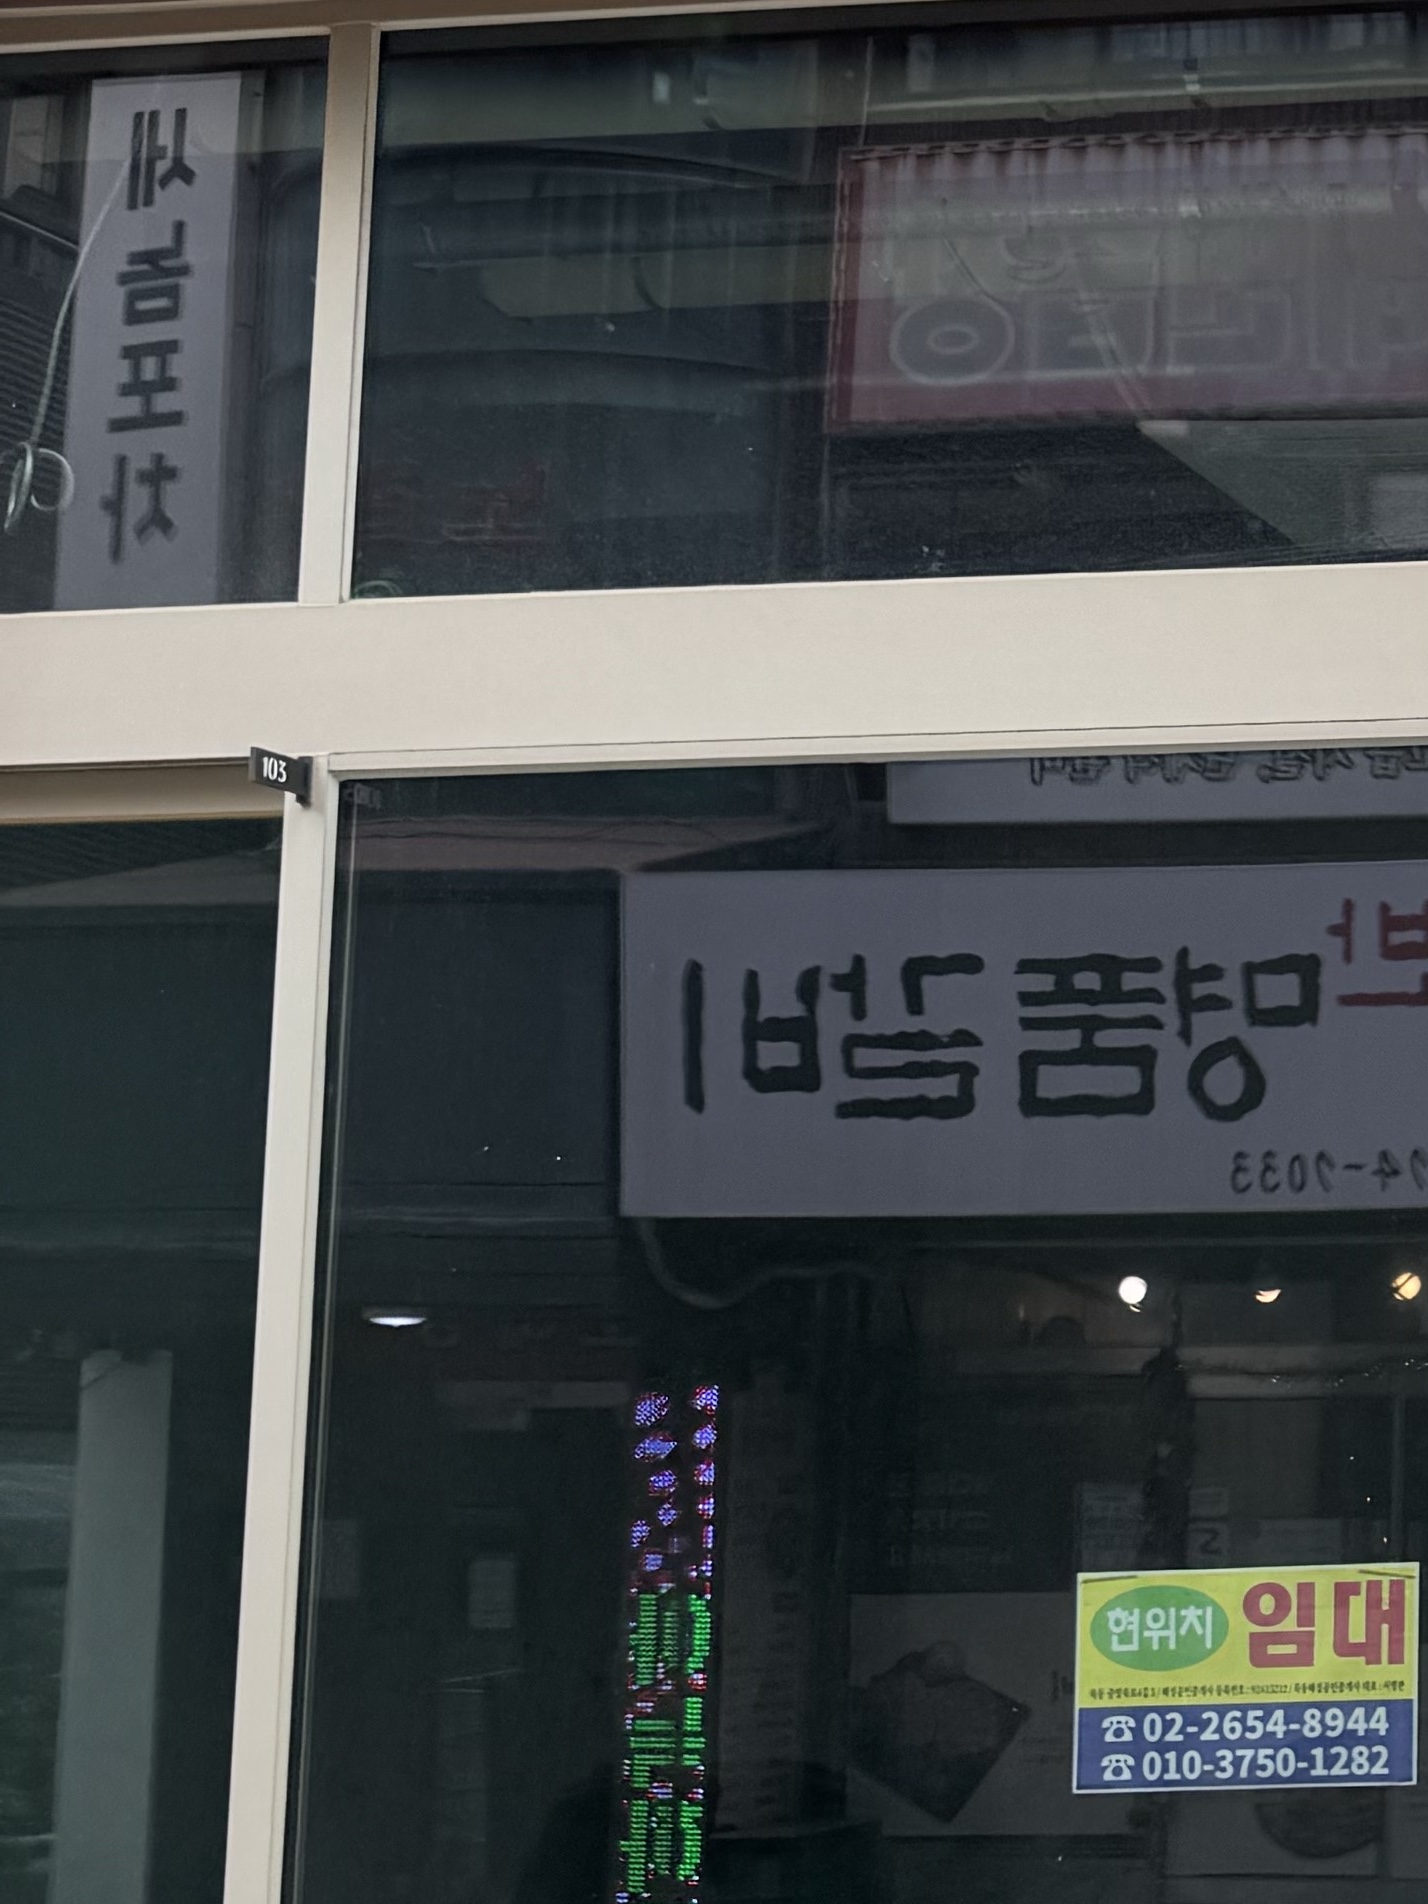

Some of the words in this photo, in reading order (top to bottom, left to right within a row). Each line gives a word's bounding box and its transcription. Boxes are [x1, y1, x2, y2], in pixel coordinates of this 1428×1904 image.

[262, 756, 287, 783] 103
[1107, 1604, 1214, 1652] 현위치
[1242, 1579, 1405, 1669] 임대
[1142, 1706, 1389, 1743] 02-2654-8944
[1142, 1745, 1389, 1781] 010-3750-1282
